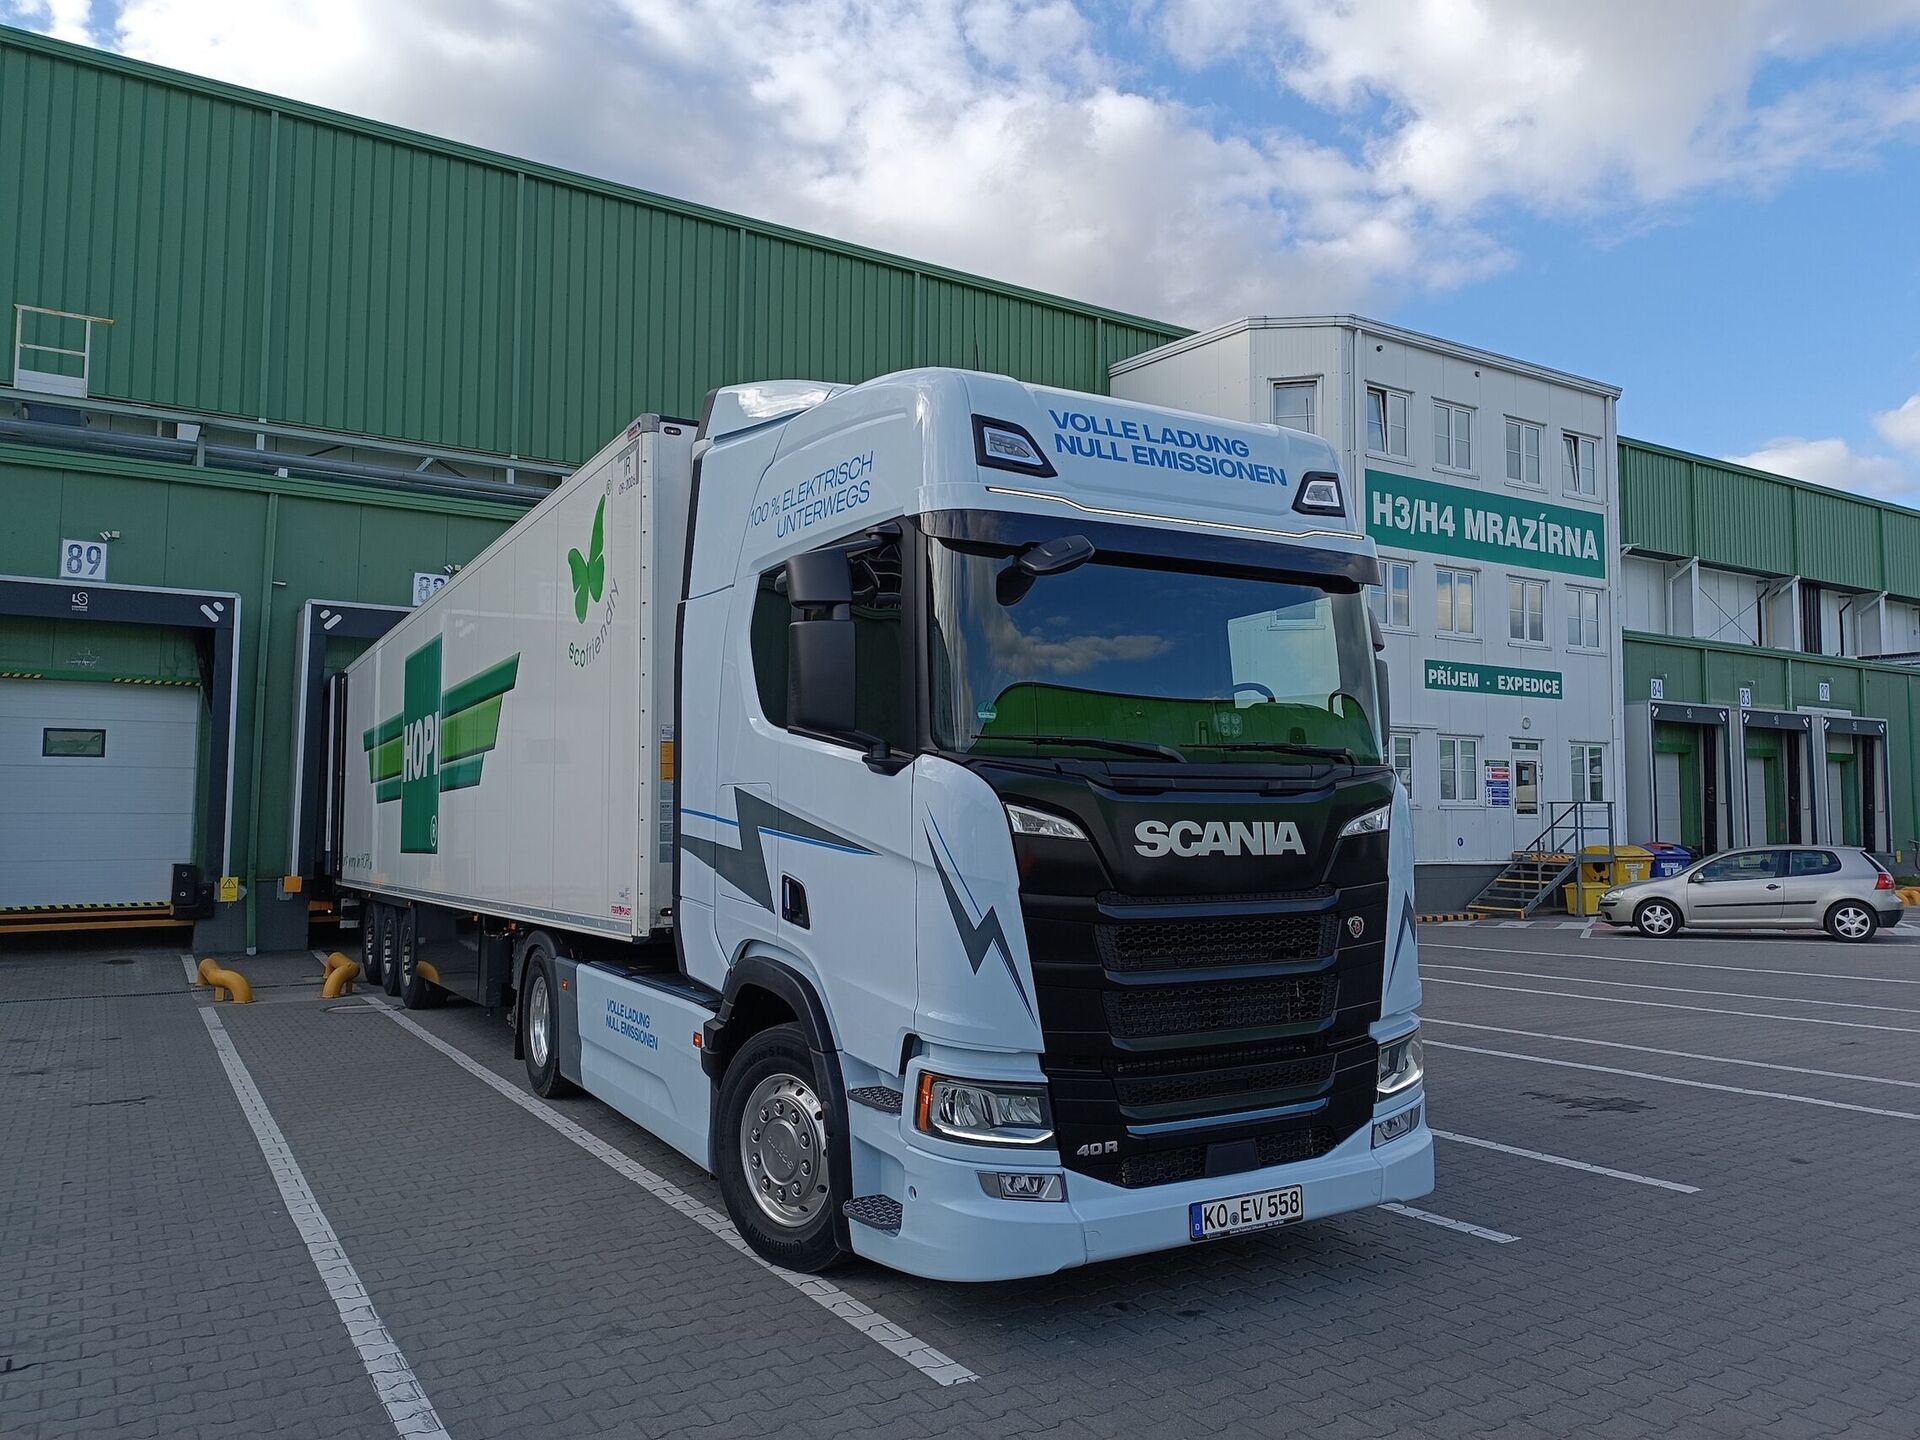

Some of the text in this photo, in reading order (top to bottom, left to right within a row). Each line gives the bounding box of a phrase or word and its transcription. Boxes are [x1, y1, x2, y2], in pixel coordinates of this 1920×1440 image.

[1048, 409, 1250, 458] VOLLE LADUNG
[1054, 433, 1288, 486] NULL EMISSIONEN
[751, 502, 770, 528] 100
[782, 450, 874, 511] ELEKTRISCH
[777, 480, 871, 538] UNTERWEGS
[1372, 491, 1599, 561] H3/H4 MRAZÍRNA
[66, 543, 102, 575] 89
[1428, 665, 1560, 694] PŘÍJEM EXPEDICE
[1653, 680, 1662, 697] 84
[1741, 689, 1750, 705] 83
[403, 710, 440, 783] HOPI
[1133, 820, 1307, 858] SCANIA
[606, 999, 650, 1029] VOLLE LADUNG
[606, 1014, 658, 1051] NULL EMISSIONEN
[1076, 1140, 1118, 1157] 40 R
[1203, 1203, 1228, 1231] KO
[1240, 1196, 1264, 1224] EV
[1267, 1190, 1300, 1218] 558
